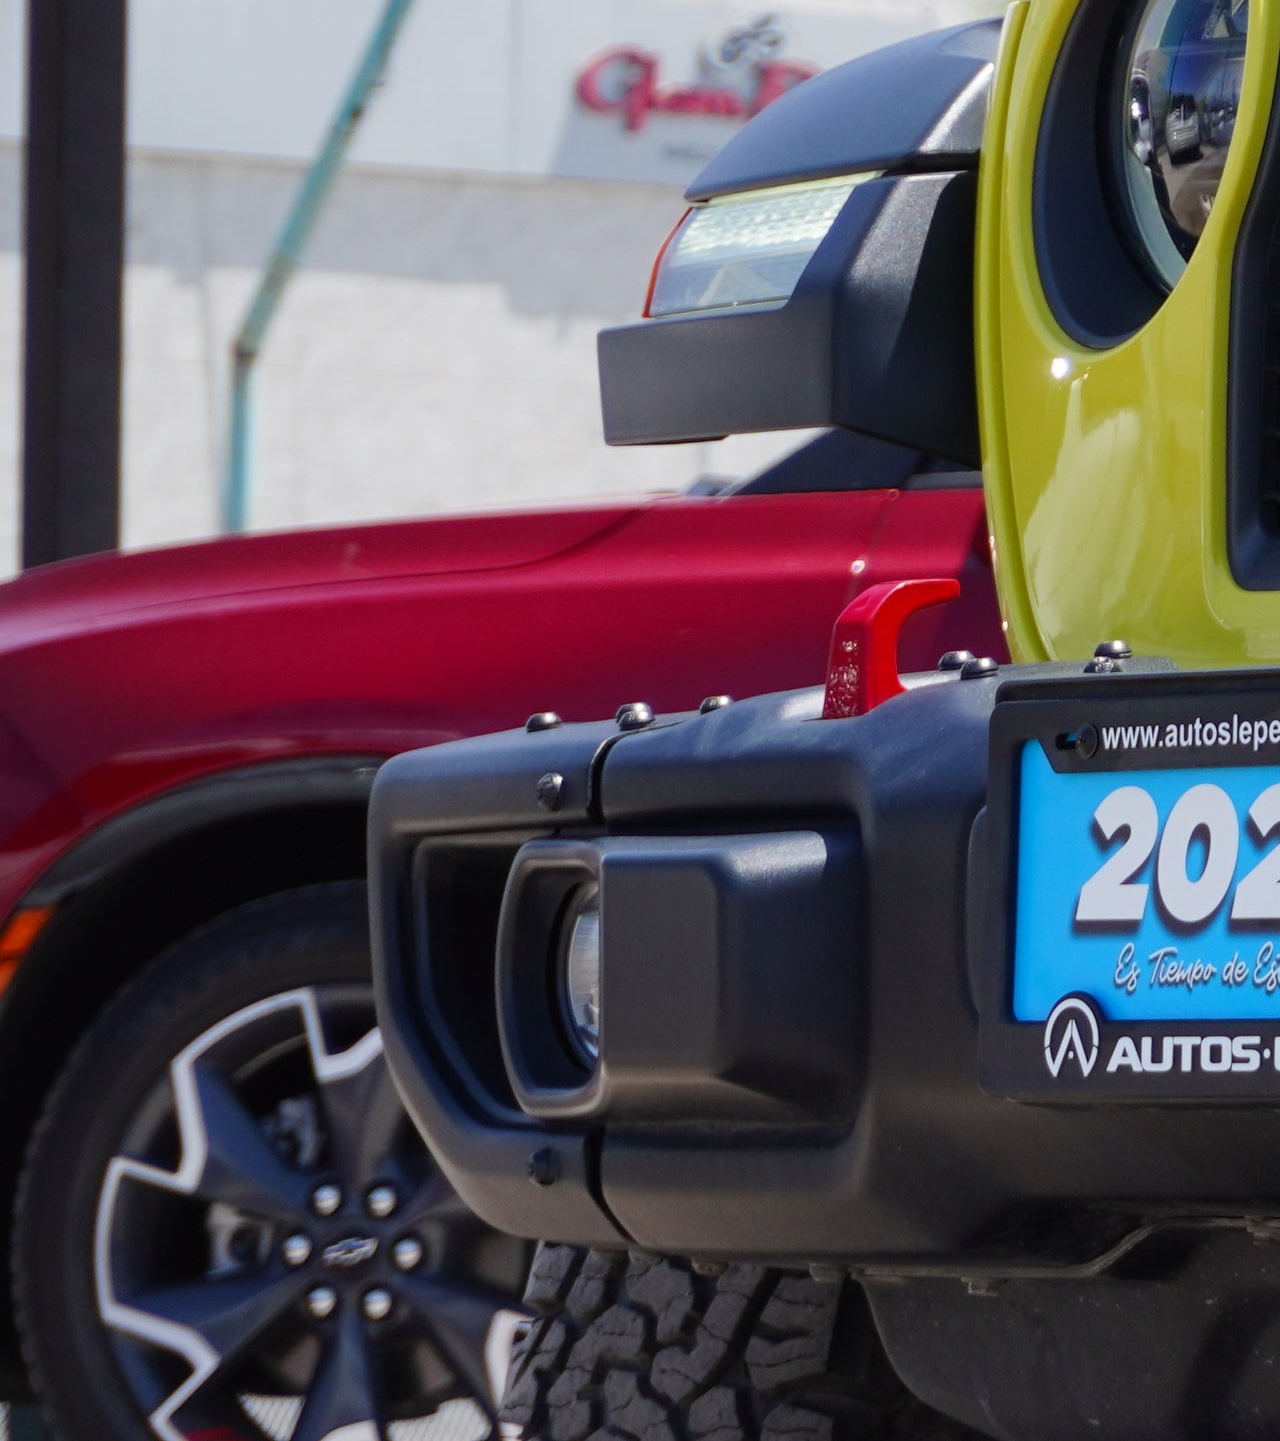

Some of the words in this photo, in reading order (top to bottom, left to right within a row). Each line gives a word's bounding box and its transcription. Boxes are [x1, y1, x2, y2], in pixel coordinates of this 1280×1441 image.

[1114, 942, 1140, 992] Es
[1148, 946, 1217, 989] Tiempo
[1221, 952, 1249, 984] de
